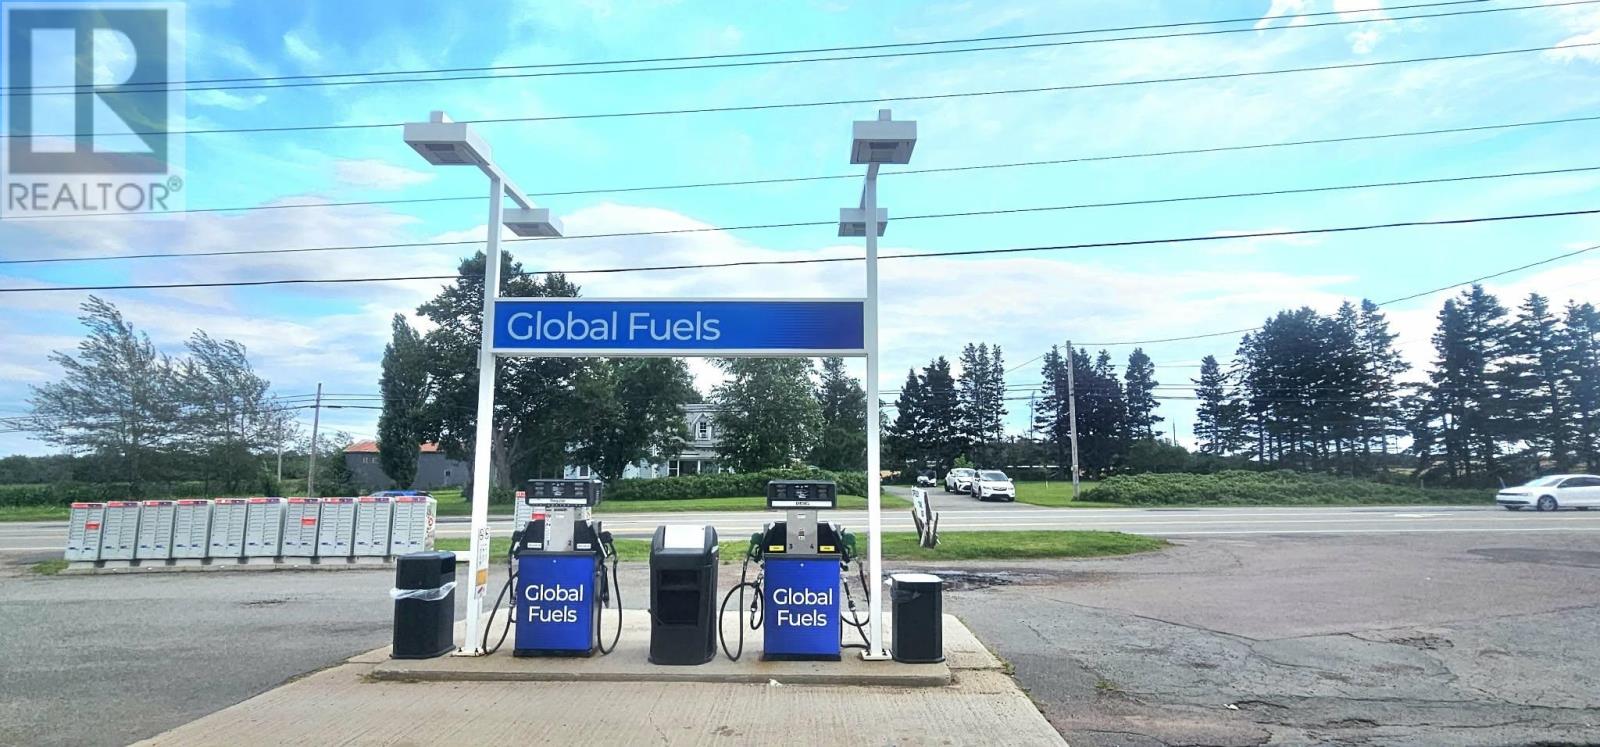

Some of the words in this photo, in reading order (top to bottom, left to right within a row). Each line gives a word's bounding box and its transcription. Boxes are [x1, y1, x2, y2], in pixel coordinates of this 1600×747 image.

[507, 310, 617, 341] Global
[629, 310, 721, 341] Fuels
[525, 584, 584, 603] Global
[773, 588, 833, 606] Global
[528, 605, 578, 623] Fuels
[777, 609, 828, 627] Fuels
